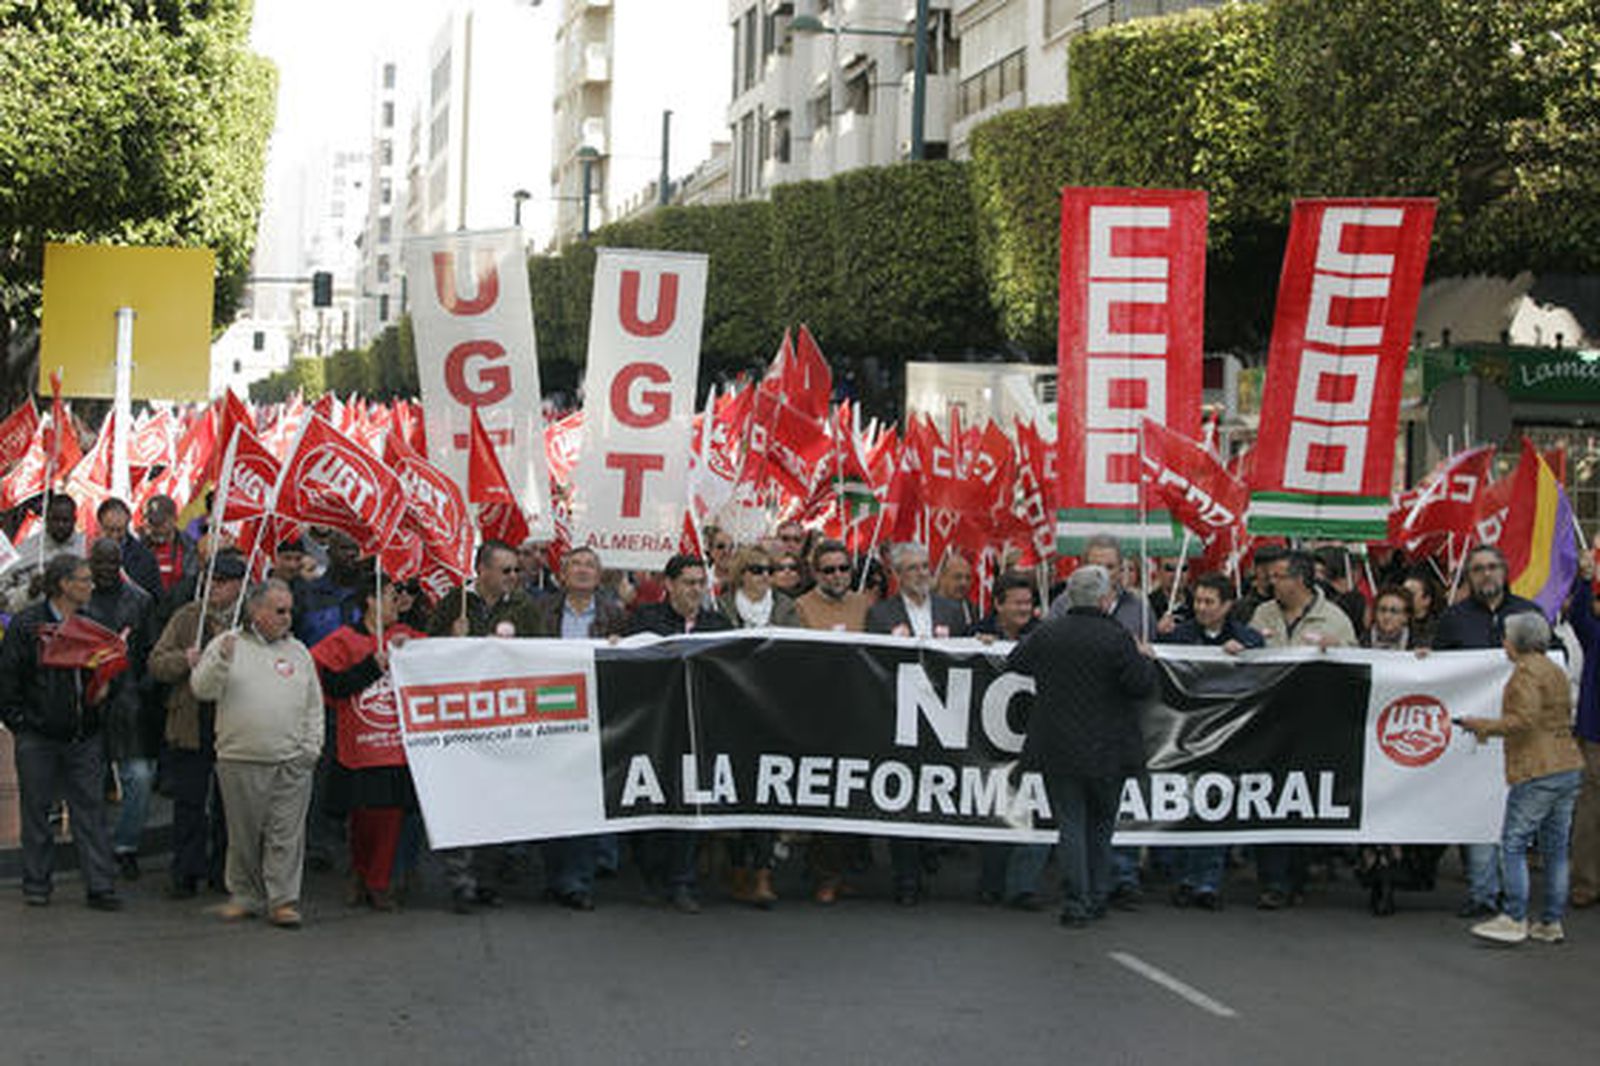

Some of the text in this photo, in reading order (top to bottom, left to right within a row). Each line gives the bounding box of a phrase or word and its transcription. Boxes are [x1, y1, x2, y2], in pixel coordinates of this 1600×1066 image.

[1282, 206, 1405, 493] CCOO
[605, 269, 680, 520] UGT
[408, 688, 526, 724] CCOO
[893, 662, 1037, 753] NO
[1387, 704, 1443, 736] UGT
[620, 753, 1351, 823] A LA REFORMA ABORAL
